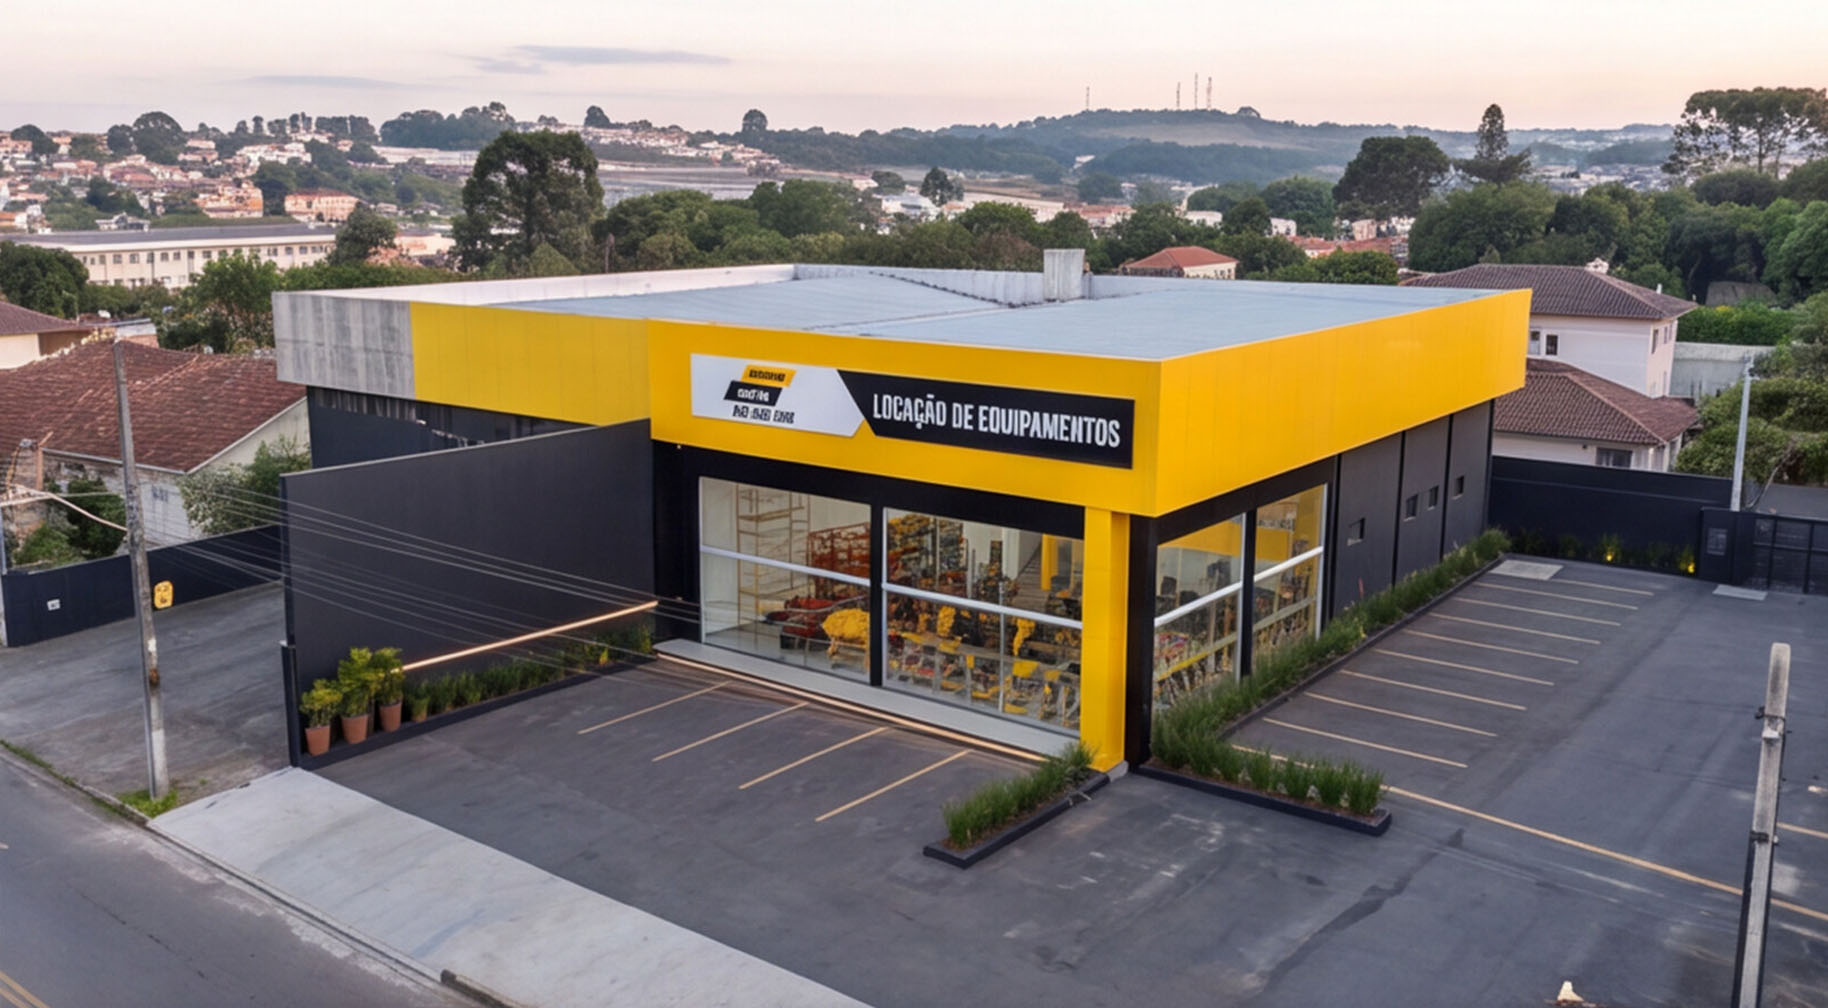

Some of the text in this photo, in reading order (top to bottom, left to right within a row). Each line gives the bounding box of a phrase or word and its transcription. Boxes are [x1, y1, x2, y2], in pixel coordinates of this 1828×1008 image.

[873, 393, 1121, 448] LOCAÇÃO DE EQUIPAMENTOS
